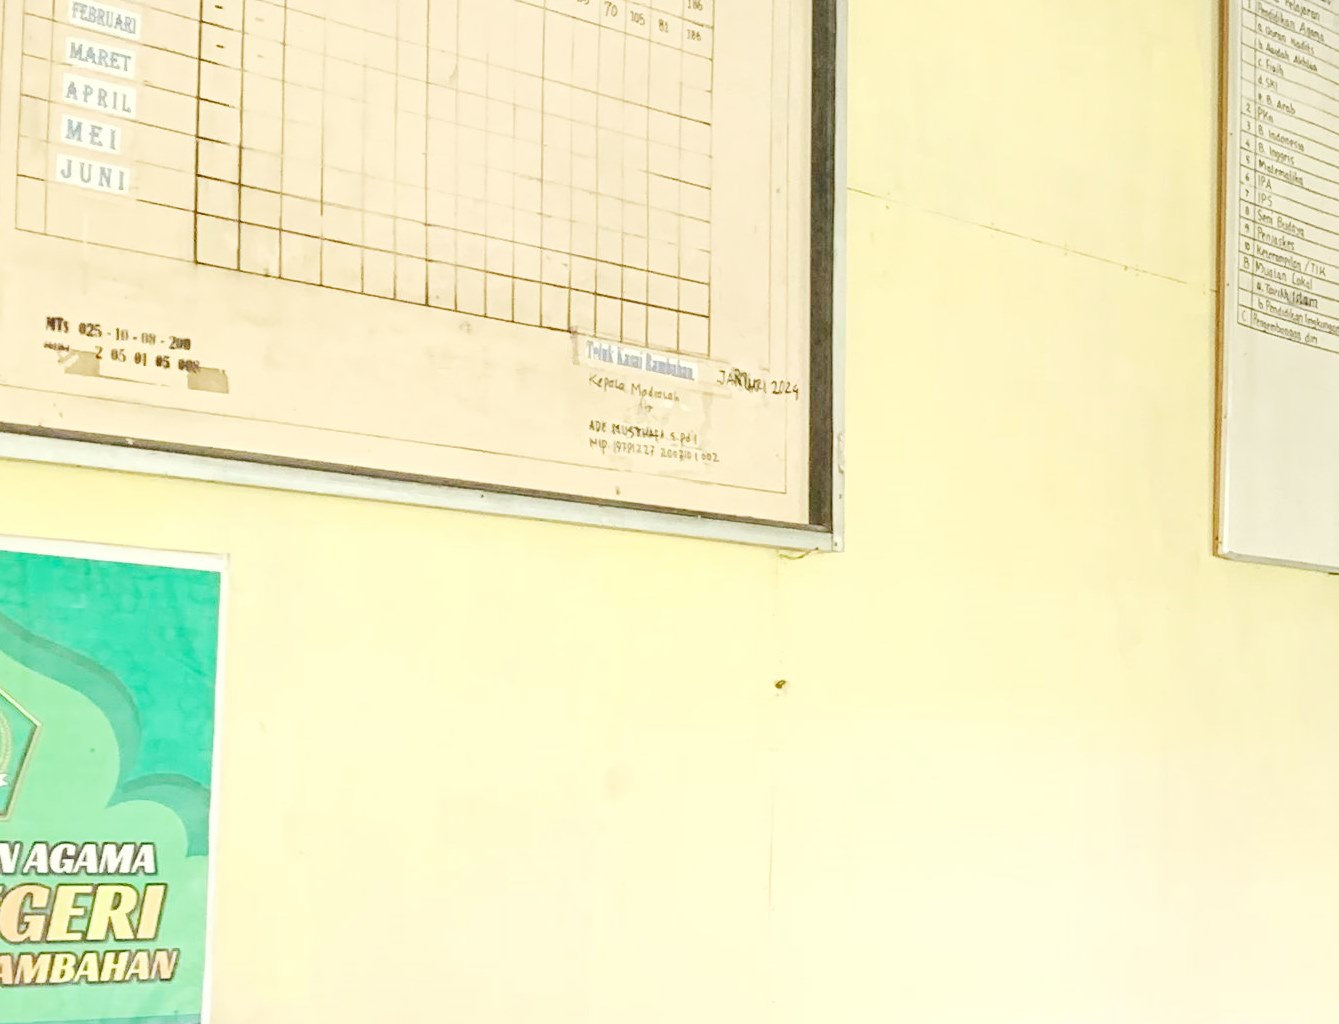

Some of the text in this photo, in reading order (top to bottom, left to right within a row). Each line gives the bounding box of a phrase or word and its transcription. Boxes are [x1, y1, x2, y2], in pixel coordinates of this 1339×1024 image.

[71, 1, 137, 35] FEBRUARI
[69, 41, 133, 72] MARET
[65, 80, 132, 114] APRIL
[65, 118, 117, 151] MEI
[61, 158, 125, 191] JUNI
[22, 841, 158, 876] AGAMA
[0, 882, 168, 945] GERI
